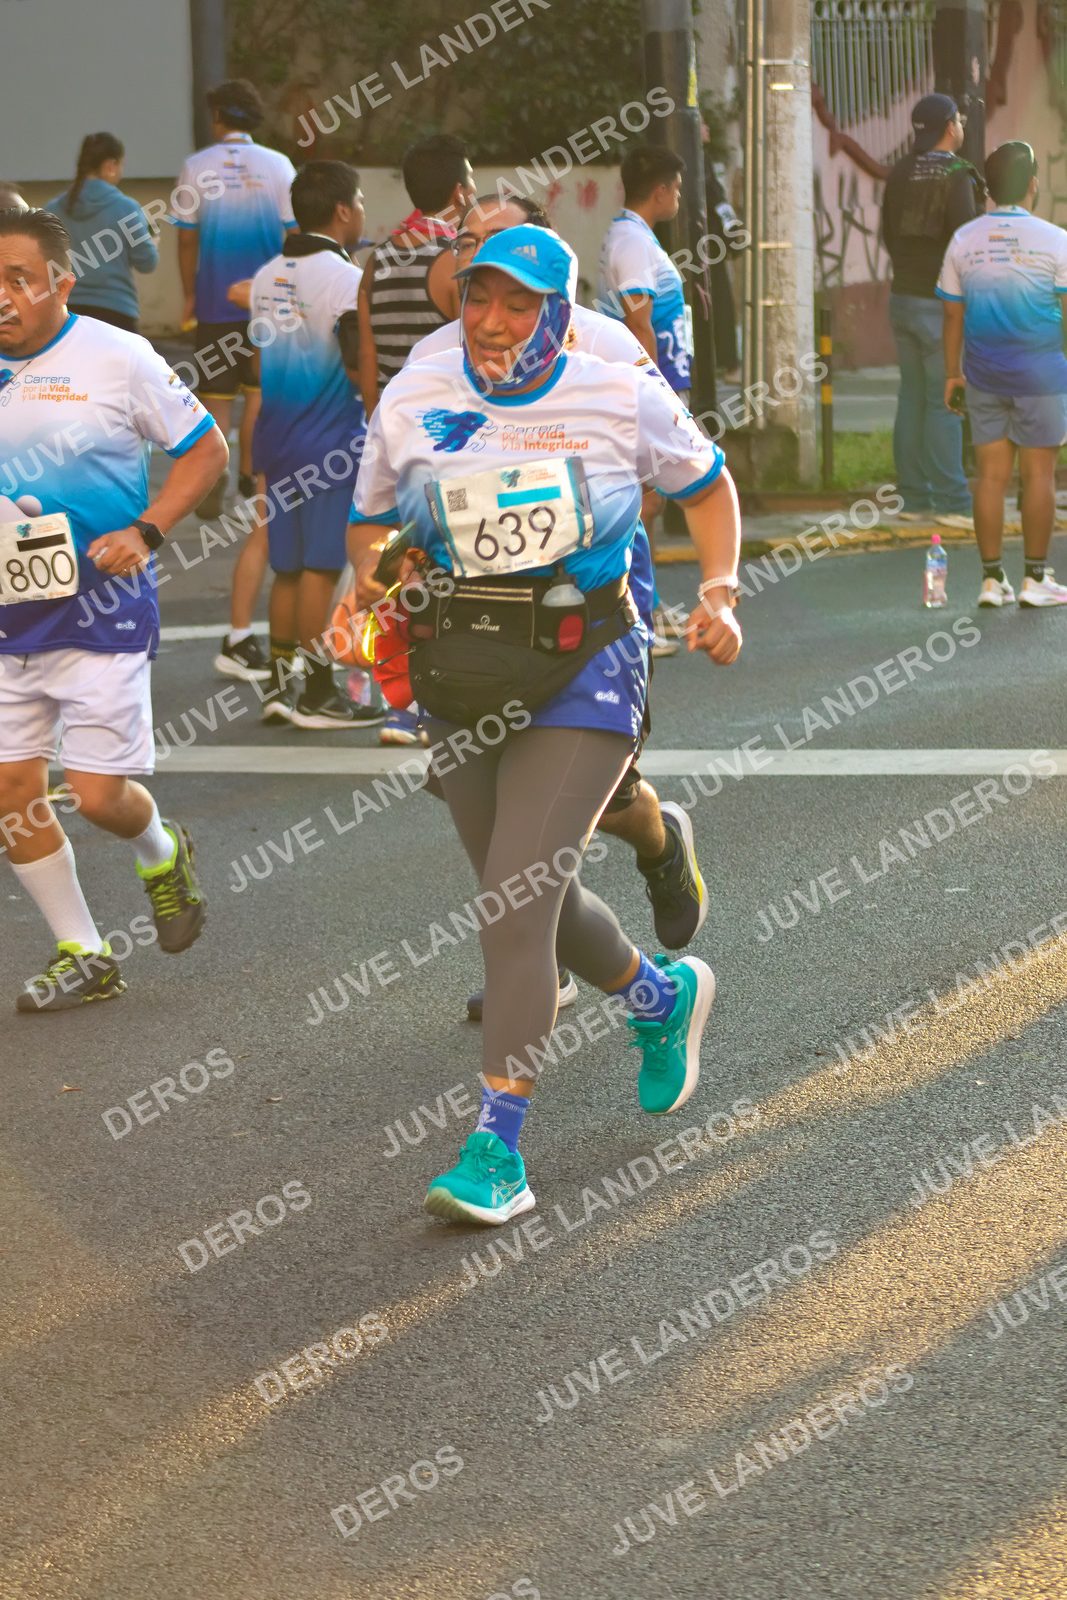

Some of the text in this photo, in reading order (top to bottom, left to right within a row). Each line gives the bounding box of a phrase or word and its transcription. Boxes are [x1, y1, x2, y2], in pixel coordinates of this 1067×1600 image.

[24, 374, 71, 384] Carrera
[49, 385, 70, 393] Vida
[38, 393, 89, 402] Integridad
[537, 430, 565, 440] Vida
[524, 438, 589, 452] Integridad
[474, 506, 556, 561] 639
[0, 550, 75, 594] 800
